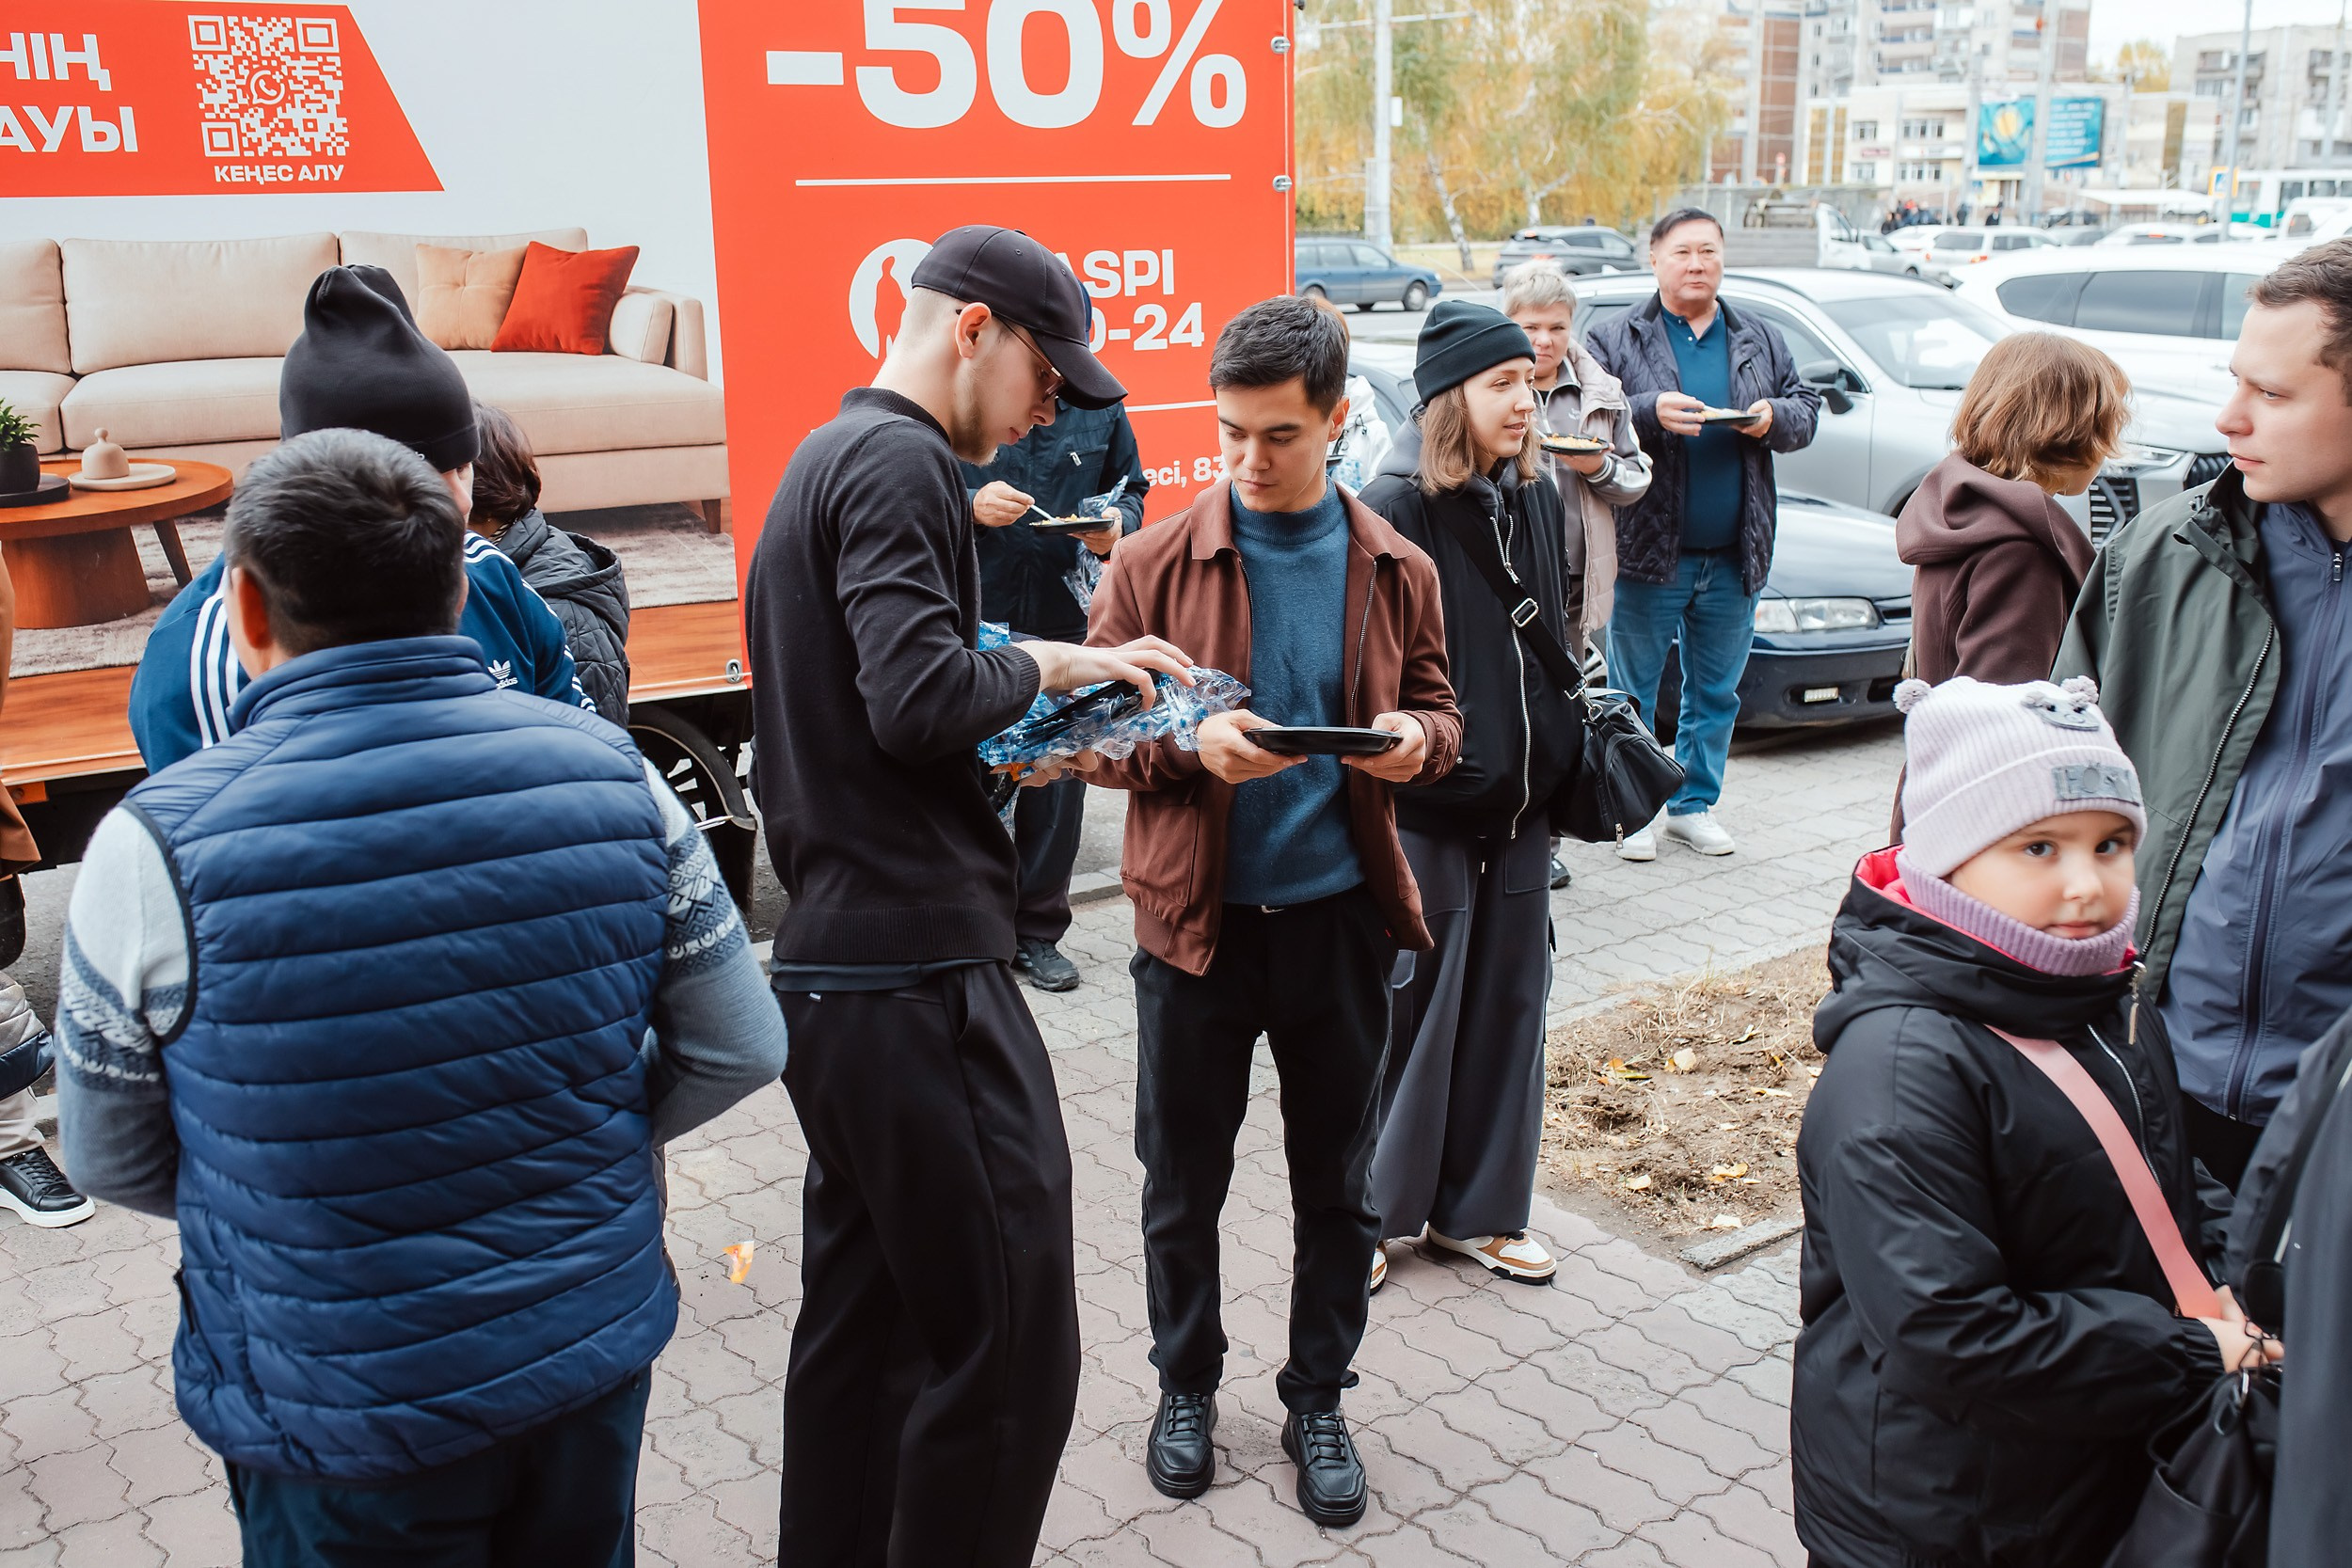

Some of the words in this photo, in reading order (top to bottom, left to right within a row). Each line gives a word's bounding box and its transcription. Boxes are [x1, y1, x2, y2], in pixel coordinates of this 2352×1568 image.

[766, 0, 1248, 129] -50%
[214, 165, 294, 185] КЕҢЕС
[297, 164, 344, 182] АЛУ
[1055, 248, 1175, 299] SPI
